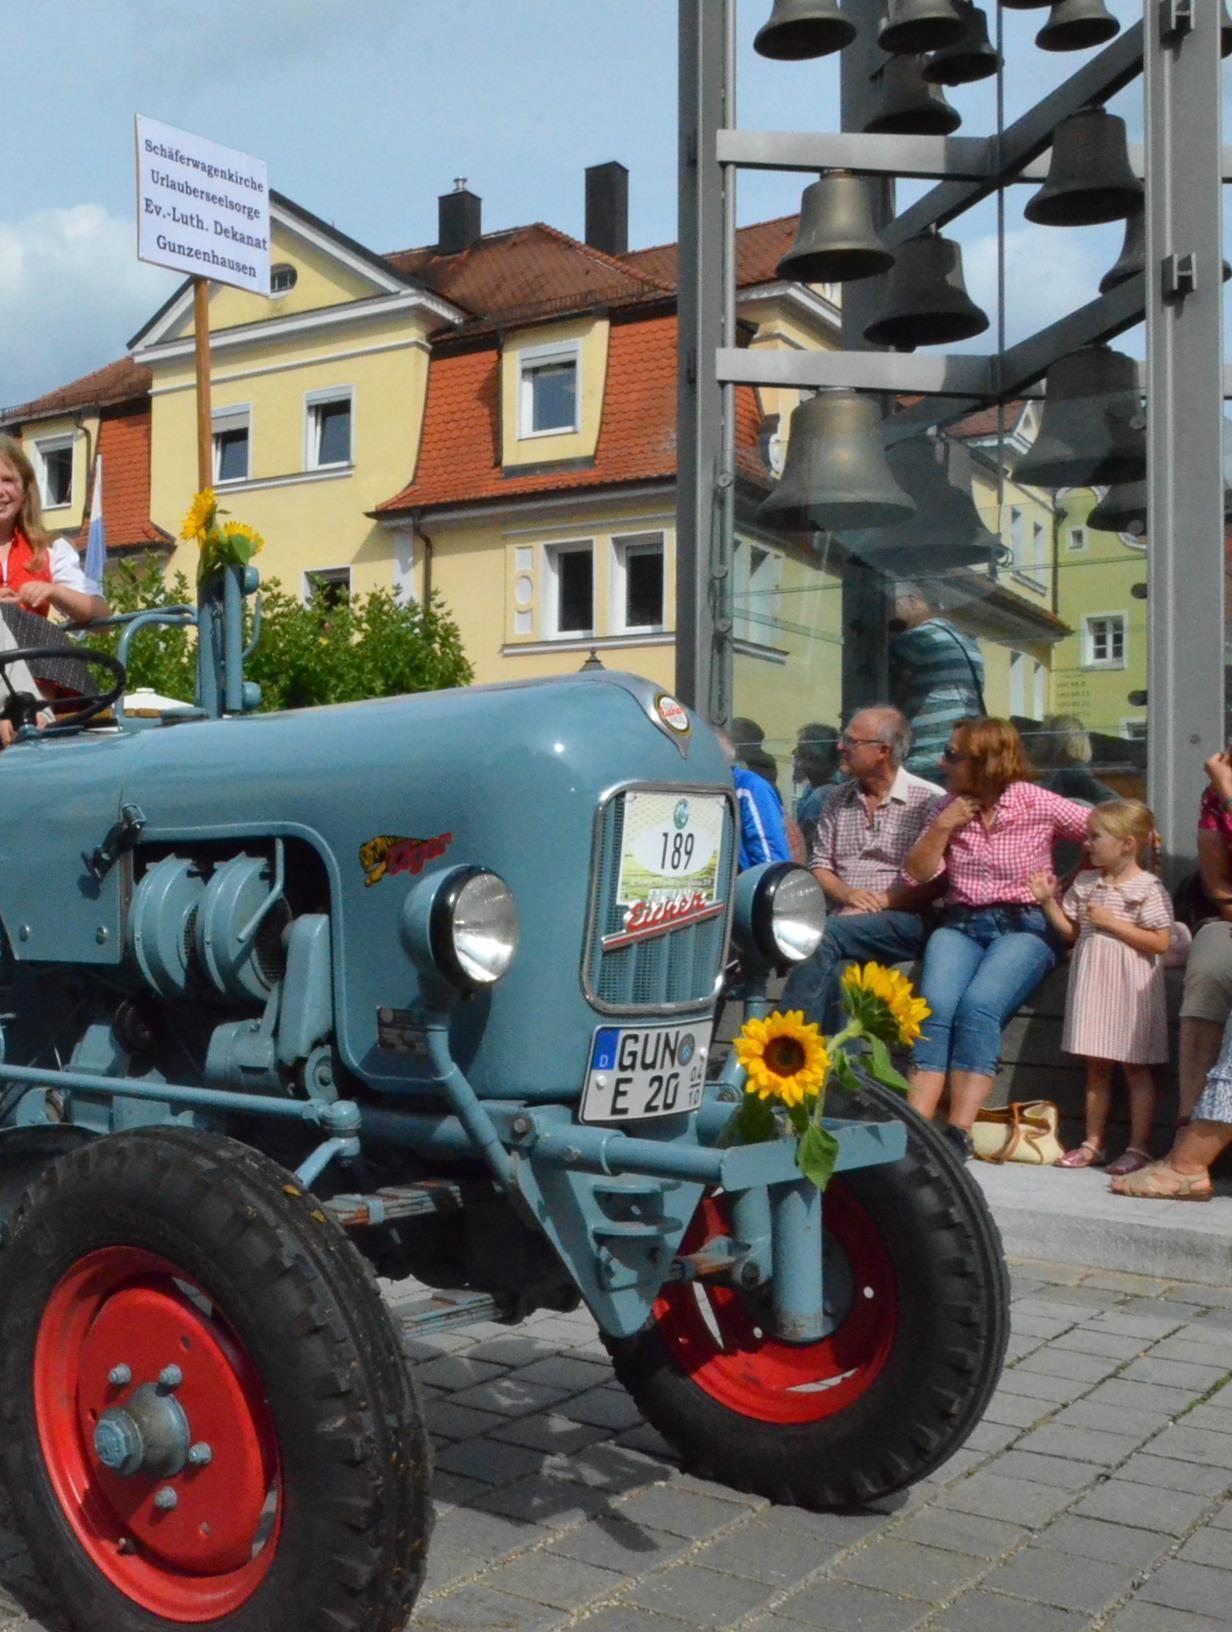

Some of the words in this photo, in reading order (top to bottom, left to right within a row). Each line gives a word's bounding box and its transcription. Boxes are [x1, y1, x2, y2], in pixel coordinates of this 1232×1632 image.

[144, 139, 264, 193] Schäferwagenkirche
[150, 169, 261, 221] Urlauberseelsorge
[144, 197, 209, 232] Ev.-Luth.
[213, 220, 268, 251] Dekanat
[156, 234, 257, 278] Gunzenhausen
[660, 832, 695, 870] 189
[598, 1054, 609, 1068] D
[618, 1030, 680, 1073] GUN
[610, 1077, 634, 1116] E
[643, 1072, 680, 1114] 20
